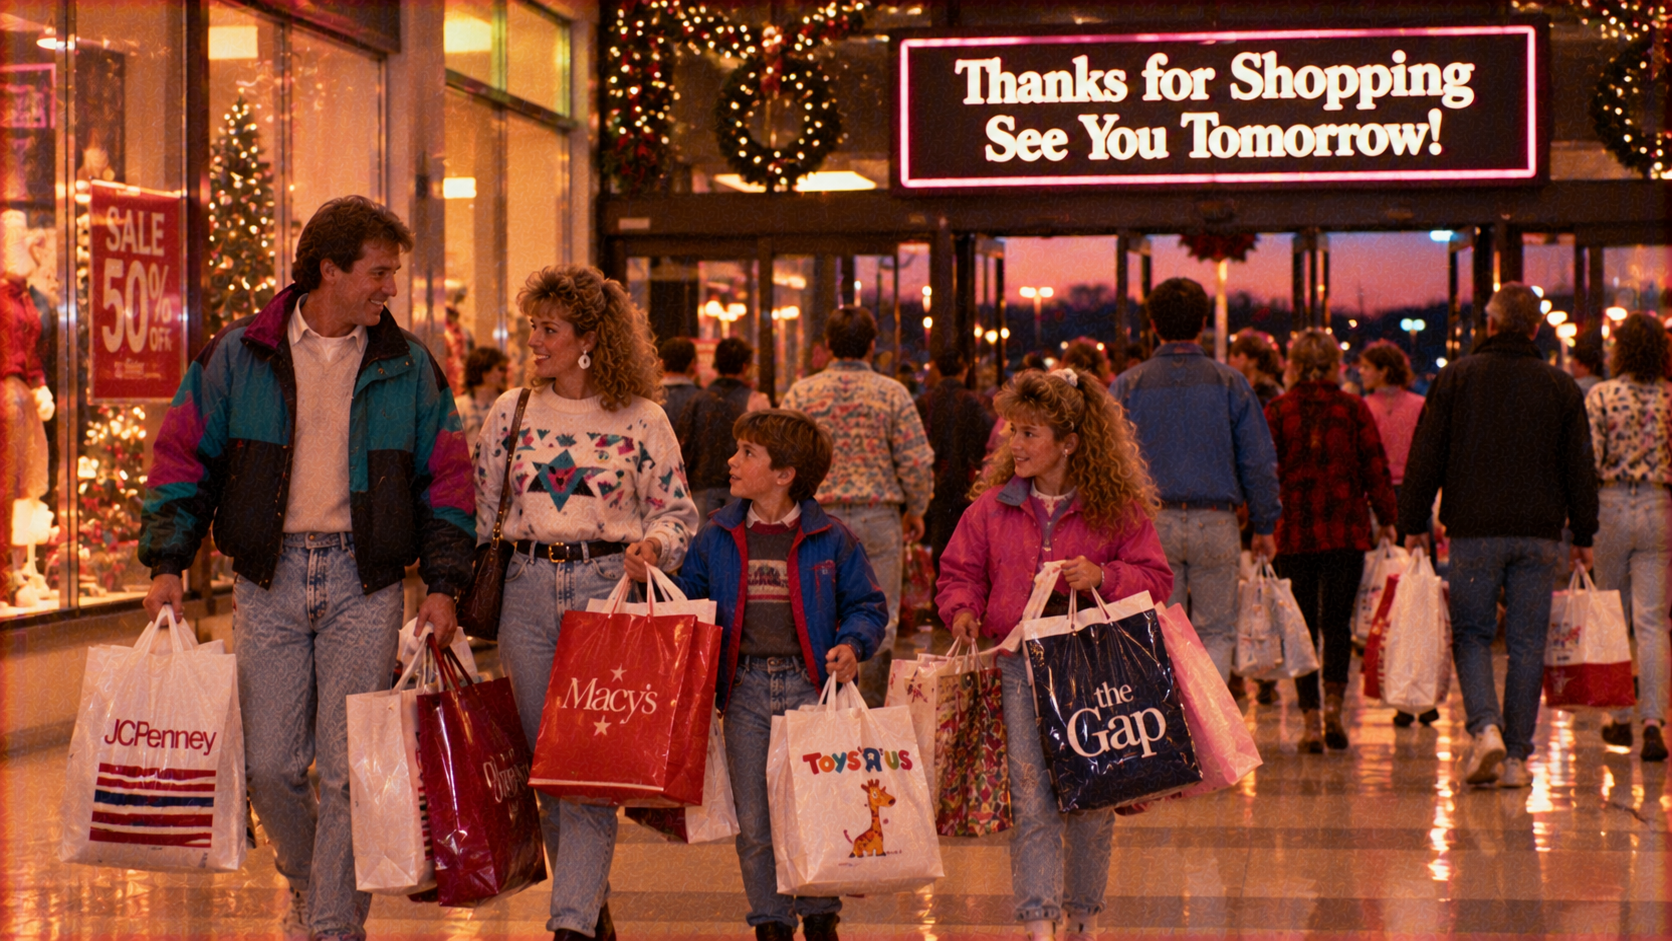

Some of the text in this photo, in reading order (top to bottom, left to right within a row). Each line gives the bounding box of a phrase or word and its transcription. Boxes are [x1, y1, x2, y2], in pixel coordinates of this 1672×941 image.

[954, 49, 1475, 111] Thanks for Shopping
[984, 107, 1443, 163] See You Tomorrow!
[105, 205, 165, 257] SALE
[102, 257, 172, 353] 50%
[561, 677, 658, 724] Macy's
[1093, 680, 1134, 708] the
[104, 718, 217, 756] JCPenney
[1066, 706, 1167, 759] Gap
